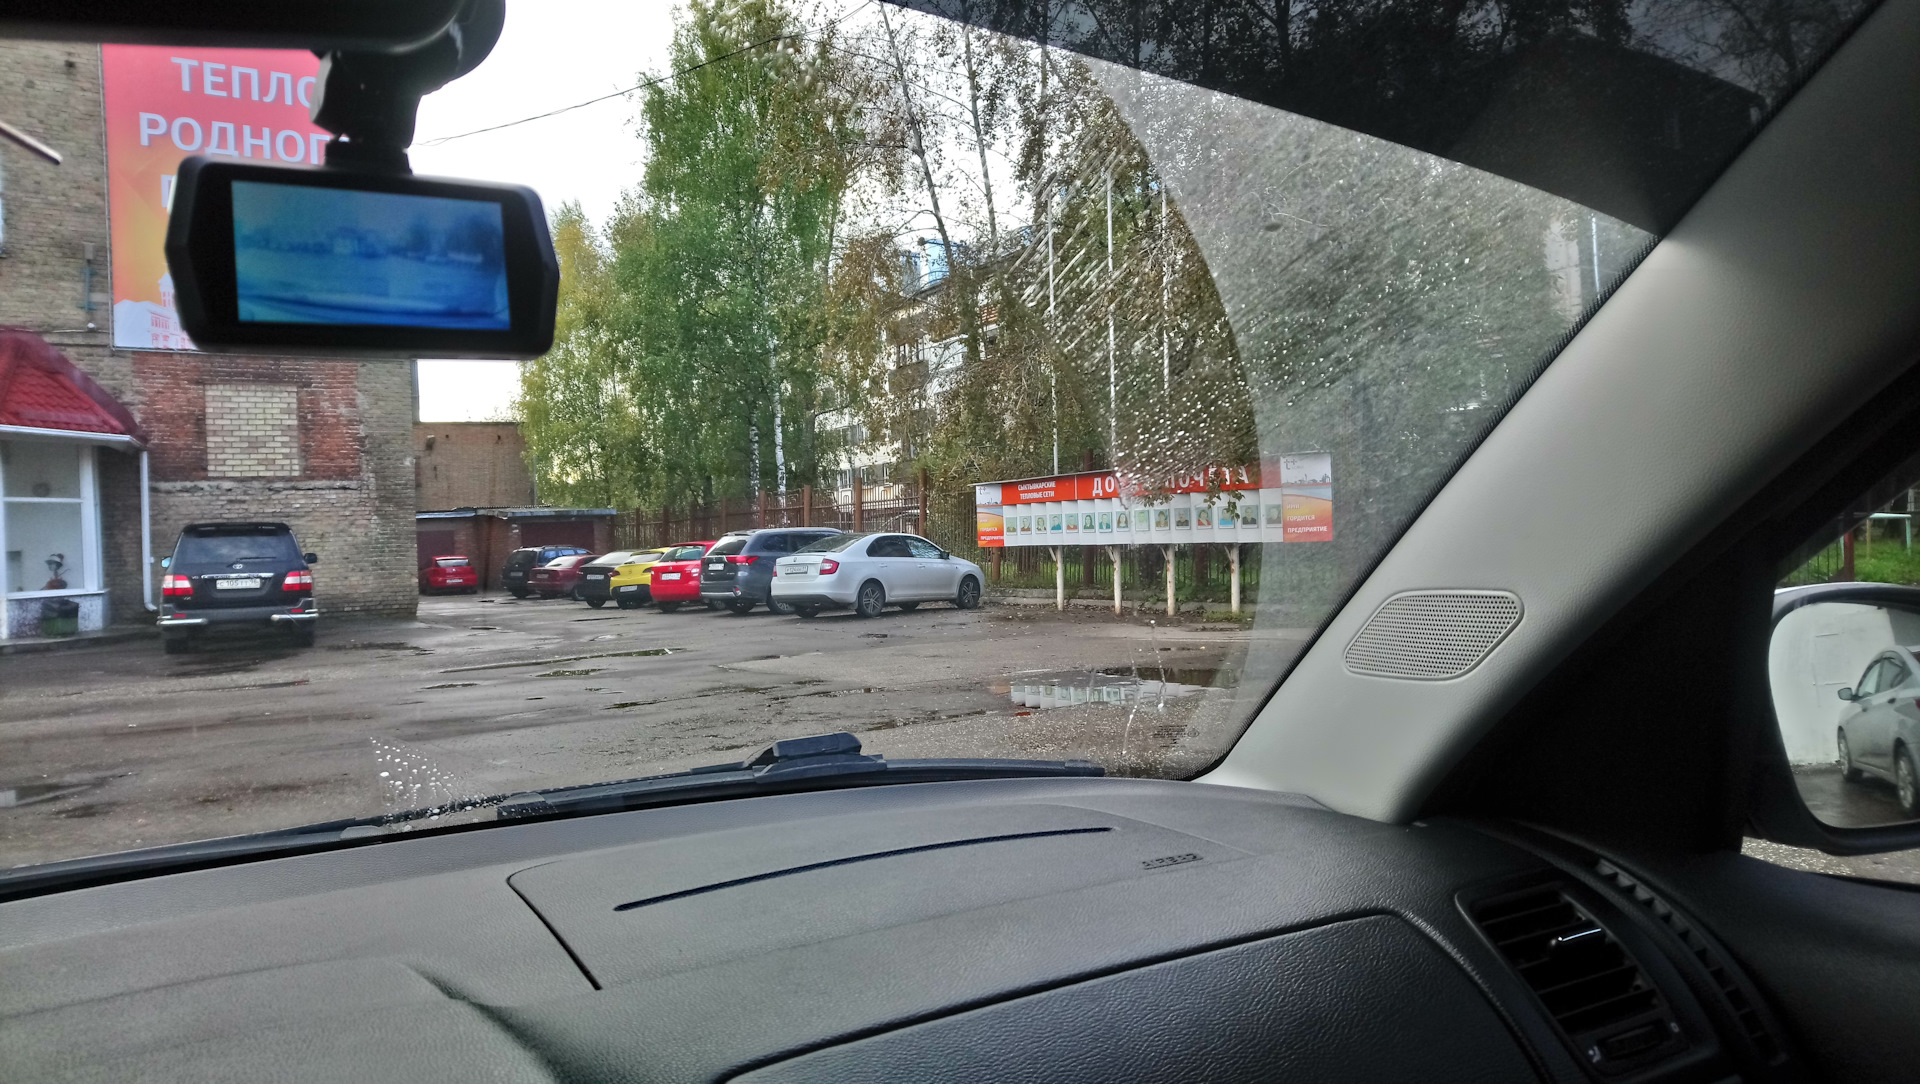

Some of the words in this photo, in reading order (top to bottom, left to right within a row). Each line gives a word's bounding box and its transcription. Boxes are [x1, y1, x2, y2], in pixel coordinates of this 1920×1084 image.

[139, 111, 349, 165] РОДНОГ
[1018, 480, 1056, 491] СЫКТЫВКАРСКИЕ
[1020, 491, 1043, 500] ТЕПЛОВЫЕ
[1043, 490, 1055, 498] СЕТИ
[1287, 514, 1315, 522] ГОРДИТСЯ
[1287, 525, 1328, 534] ПРЕДПРИЯТИЕ
